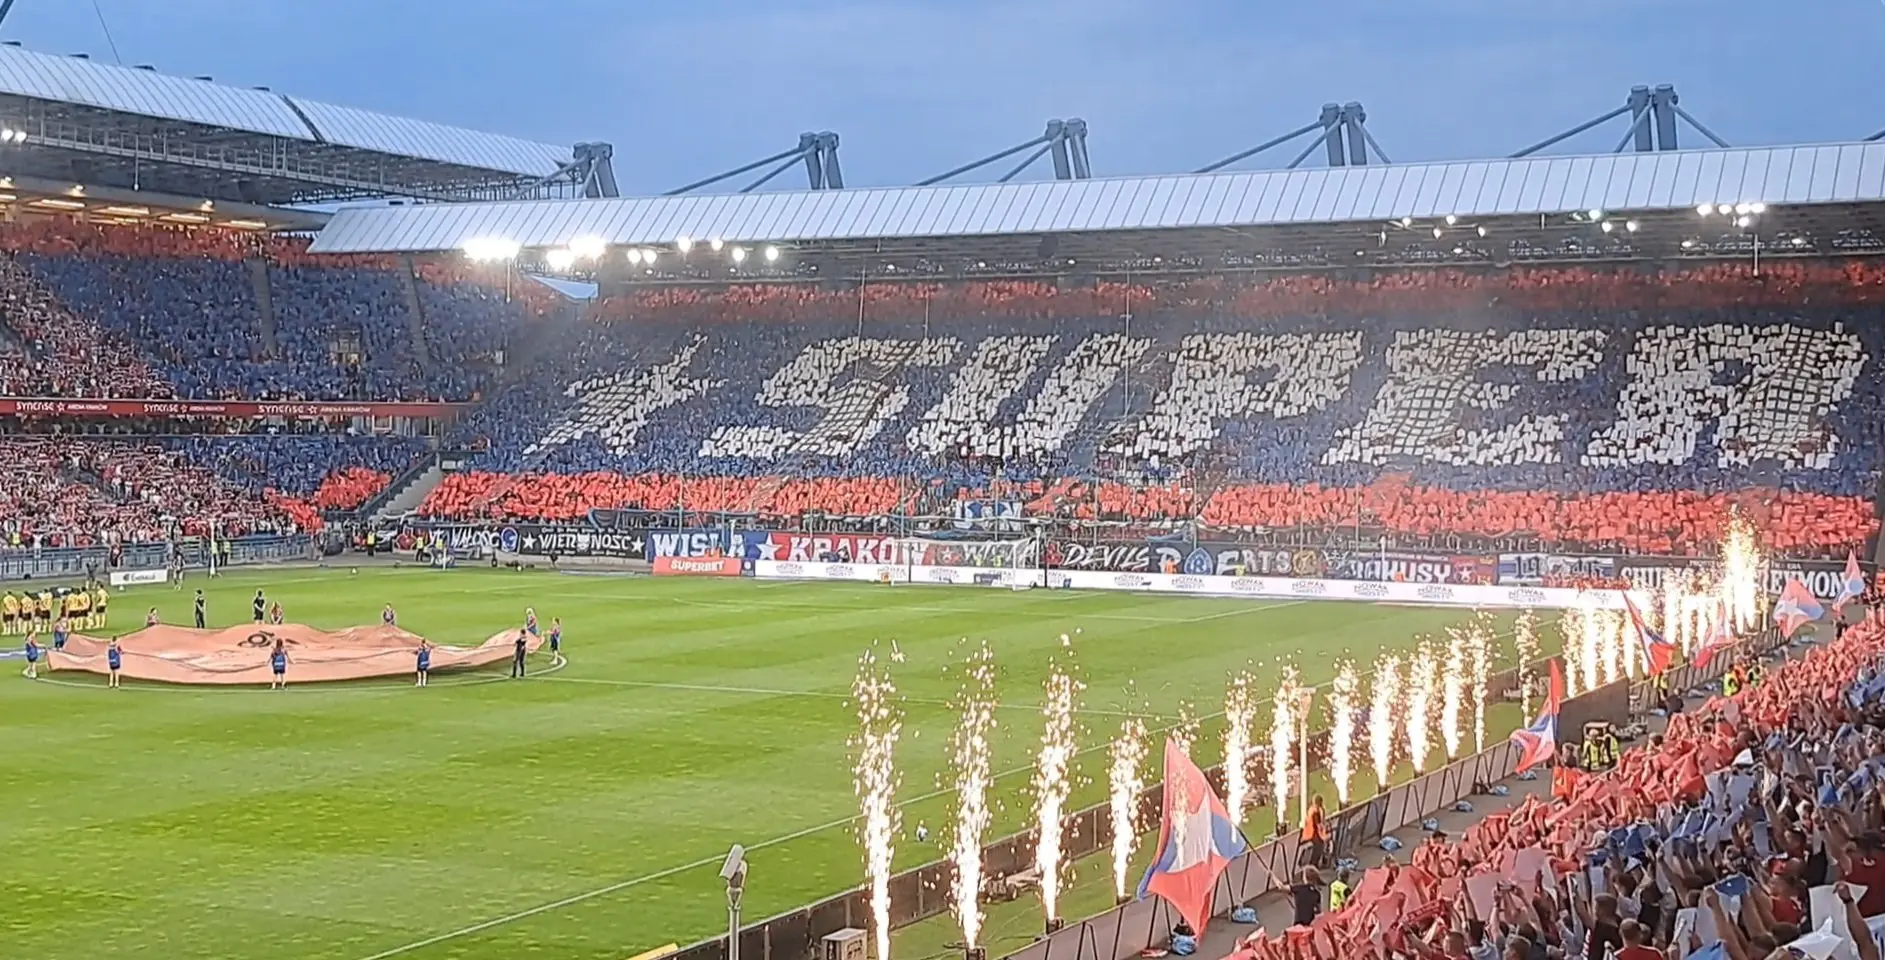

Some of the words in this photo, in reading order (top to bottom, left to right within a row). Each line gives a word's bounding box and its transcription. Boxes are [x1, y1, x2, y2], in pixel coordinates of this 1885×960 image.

[706, 323, 1867, 468] SUPER
[671, 560, 724, 572] SUPERBET
[1063, 543, 1150, 568] DEVILS
